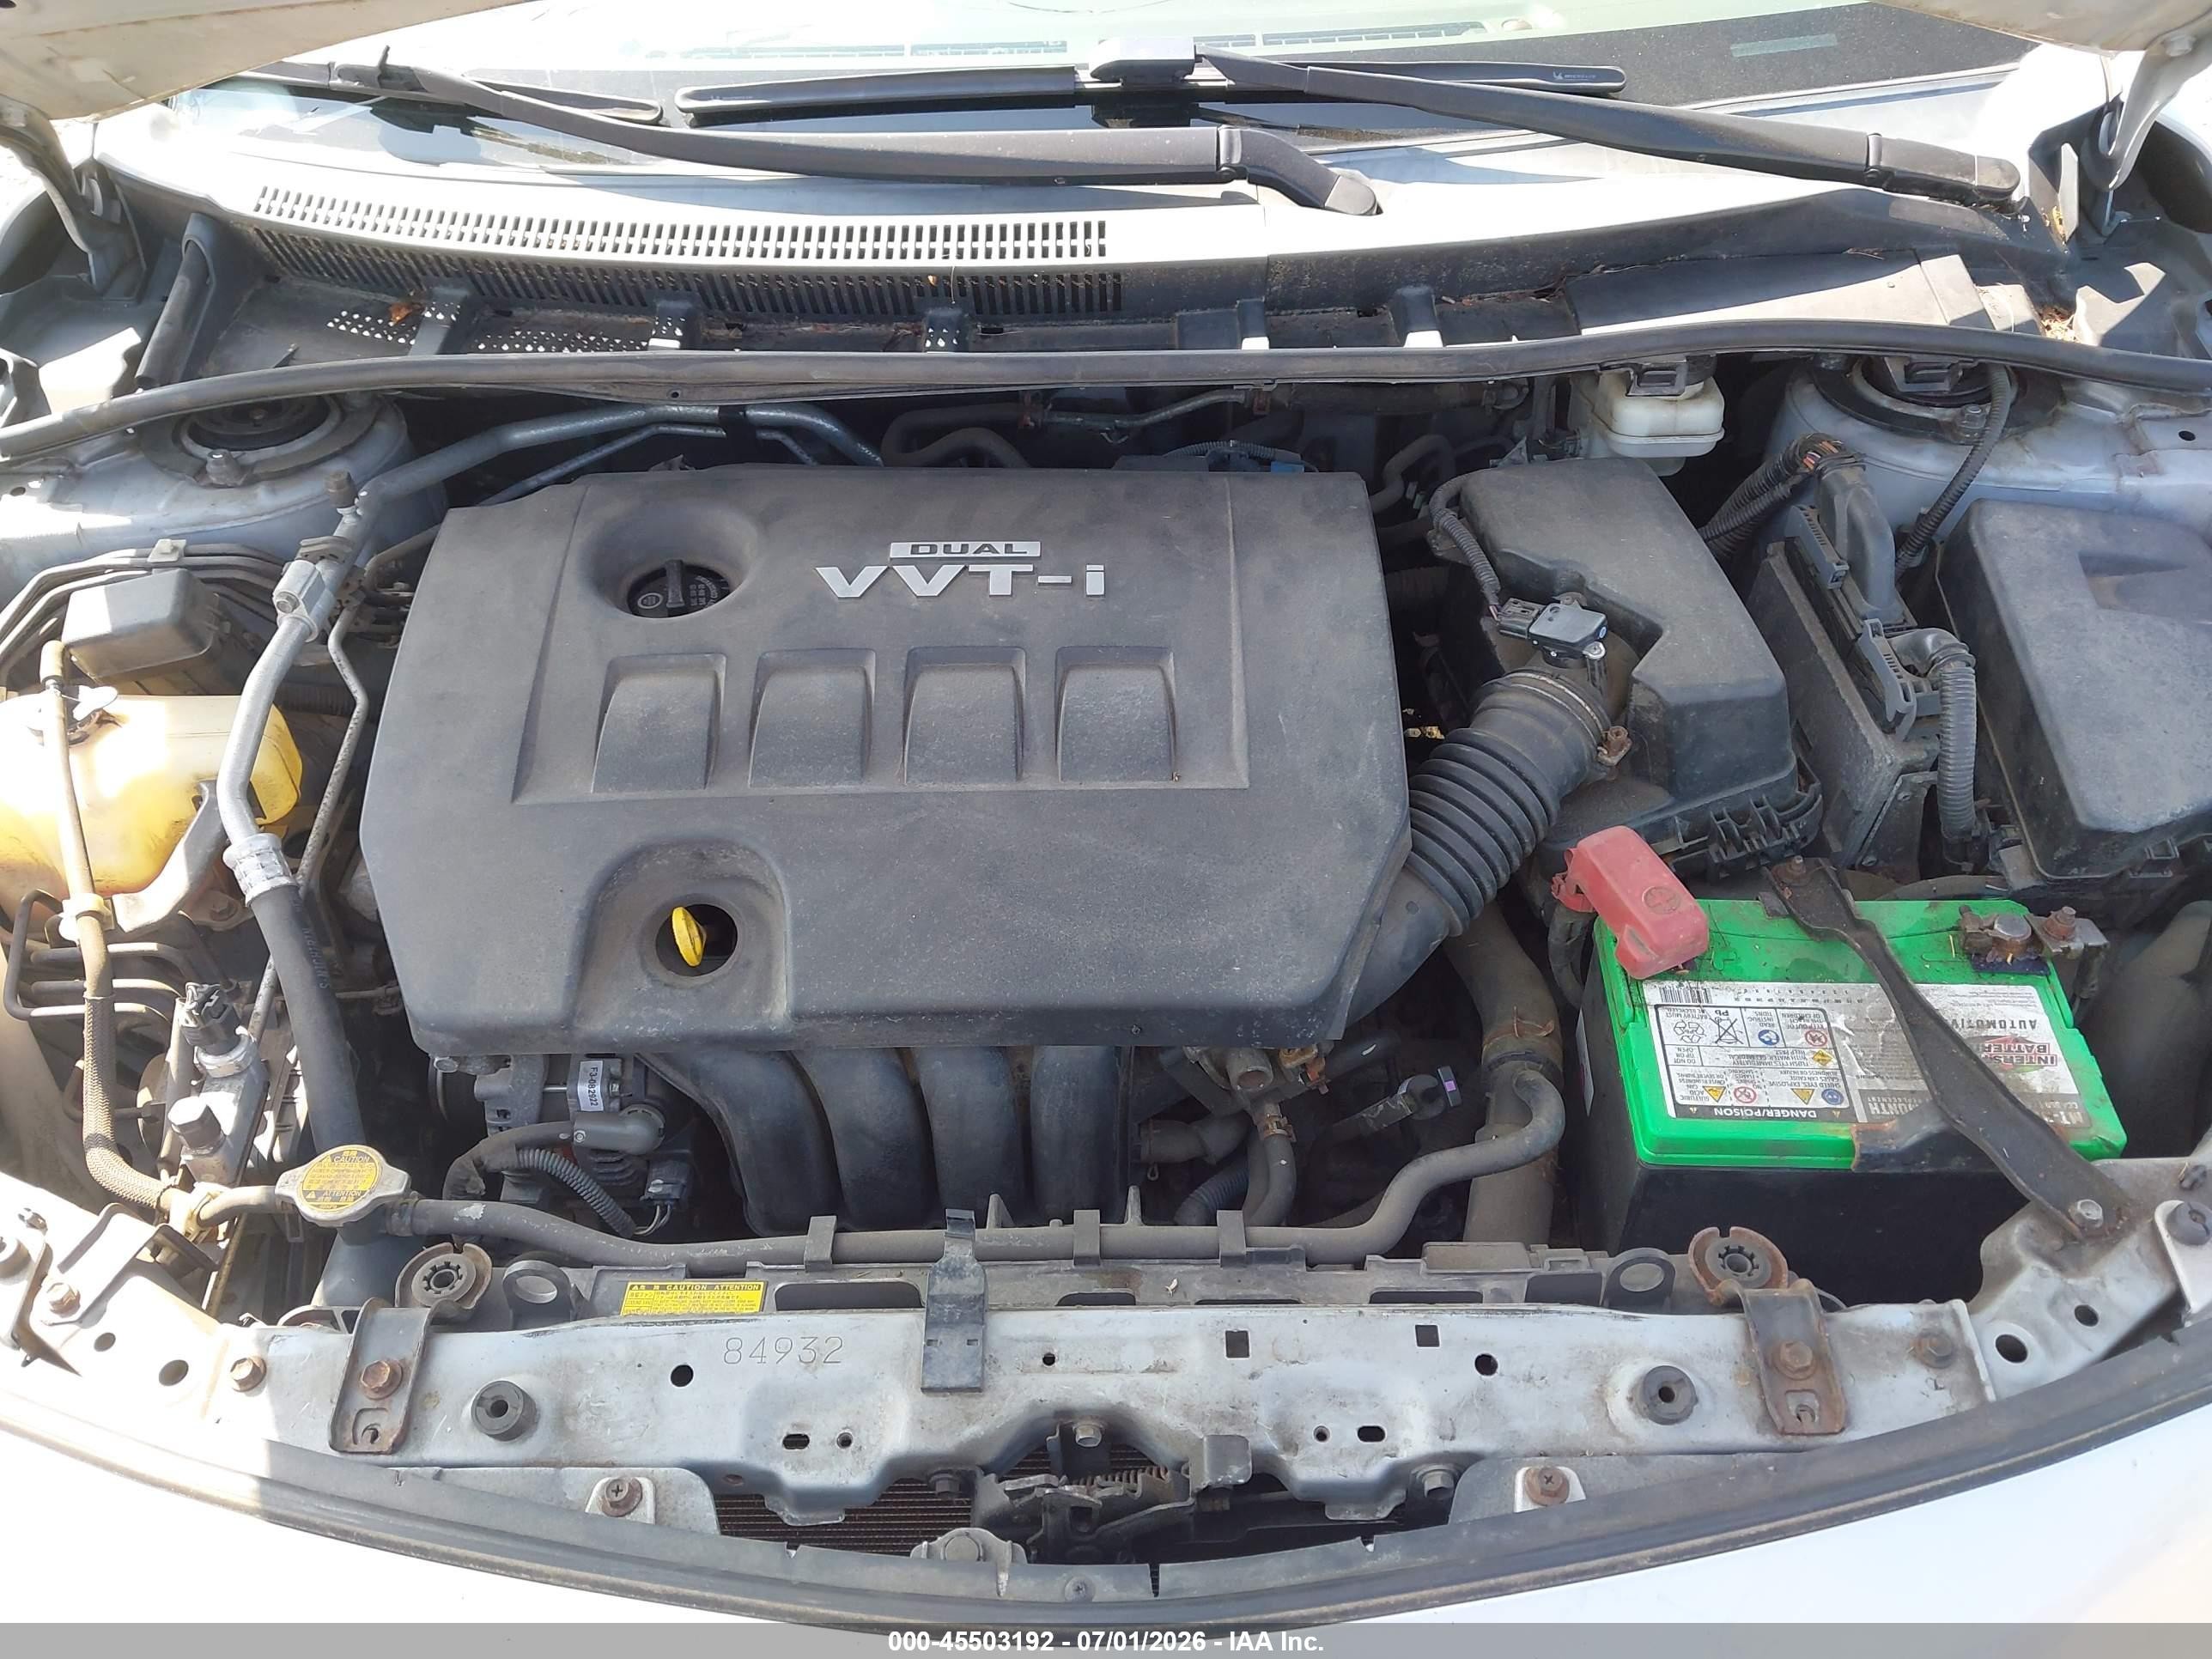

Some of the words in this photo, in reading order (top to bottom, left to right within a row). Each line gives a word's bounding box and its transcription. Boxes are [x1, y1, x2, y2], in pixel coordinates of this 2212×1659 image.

[910, 544, 1028, 555] DUAL
[816, 564, 1105, 598] VVT-i
[1944, 1018, 2037, 1030] AUTOMOTIV
[1981, 1044, 2047, 1053] BATTER
[1981, 1054, 2054, 1065] INTERS
[1714, 1108, 1817, 1118] DANGER/POISON
[724, 1336, 843, 1364] 84932
